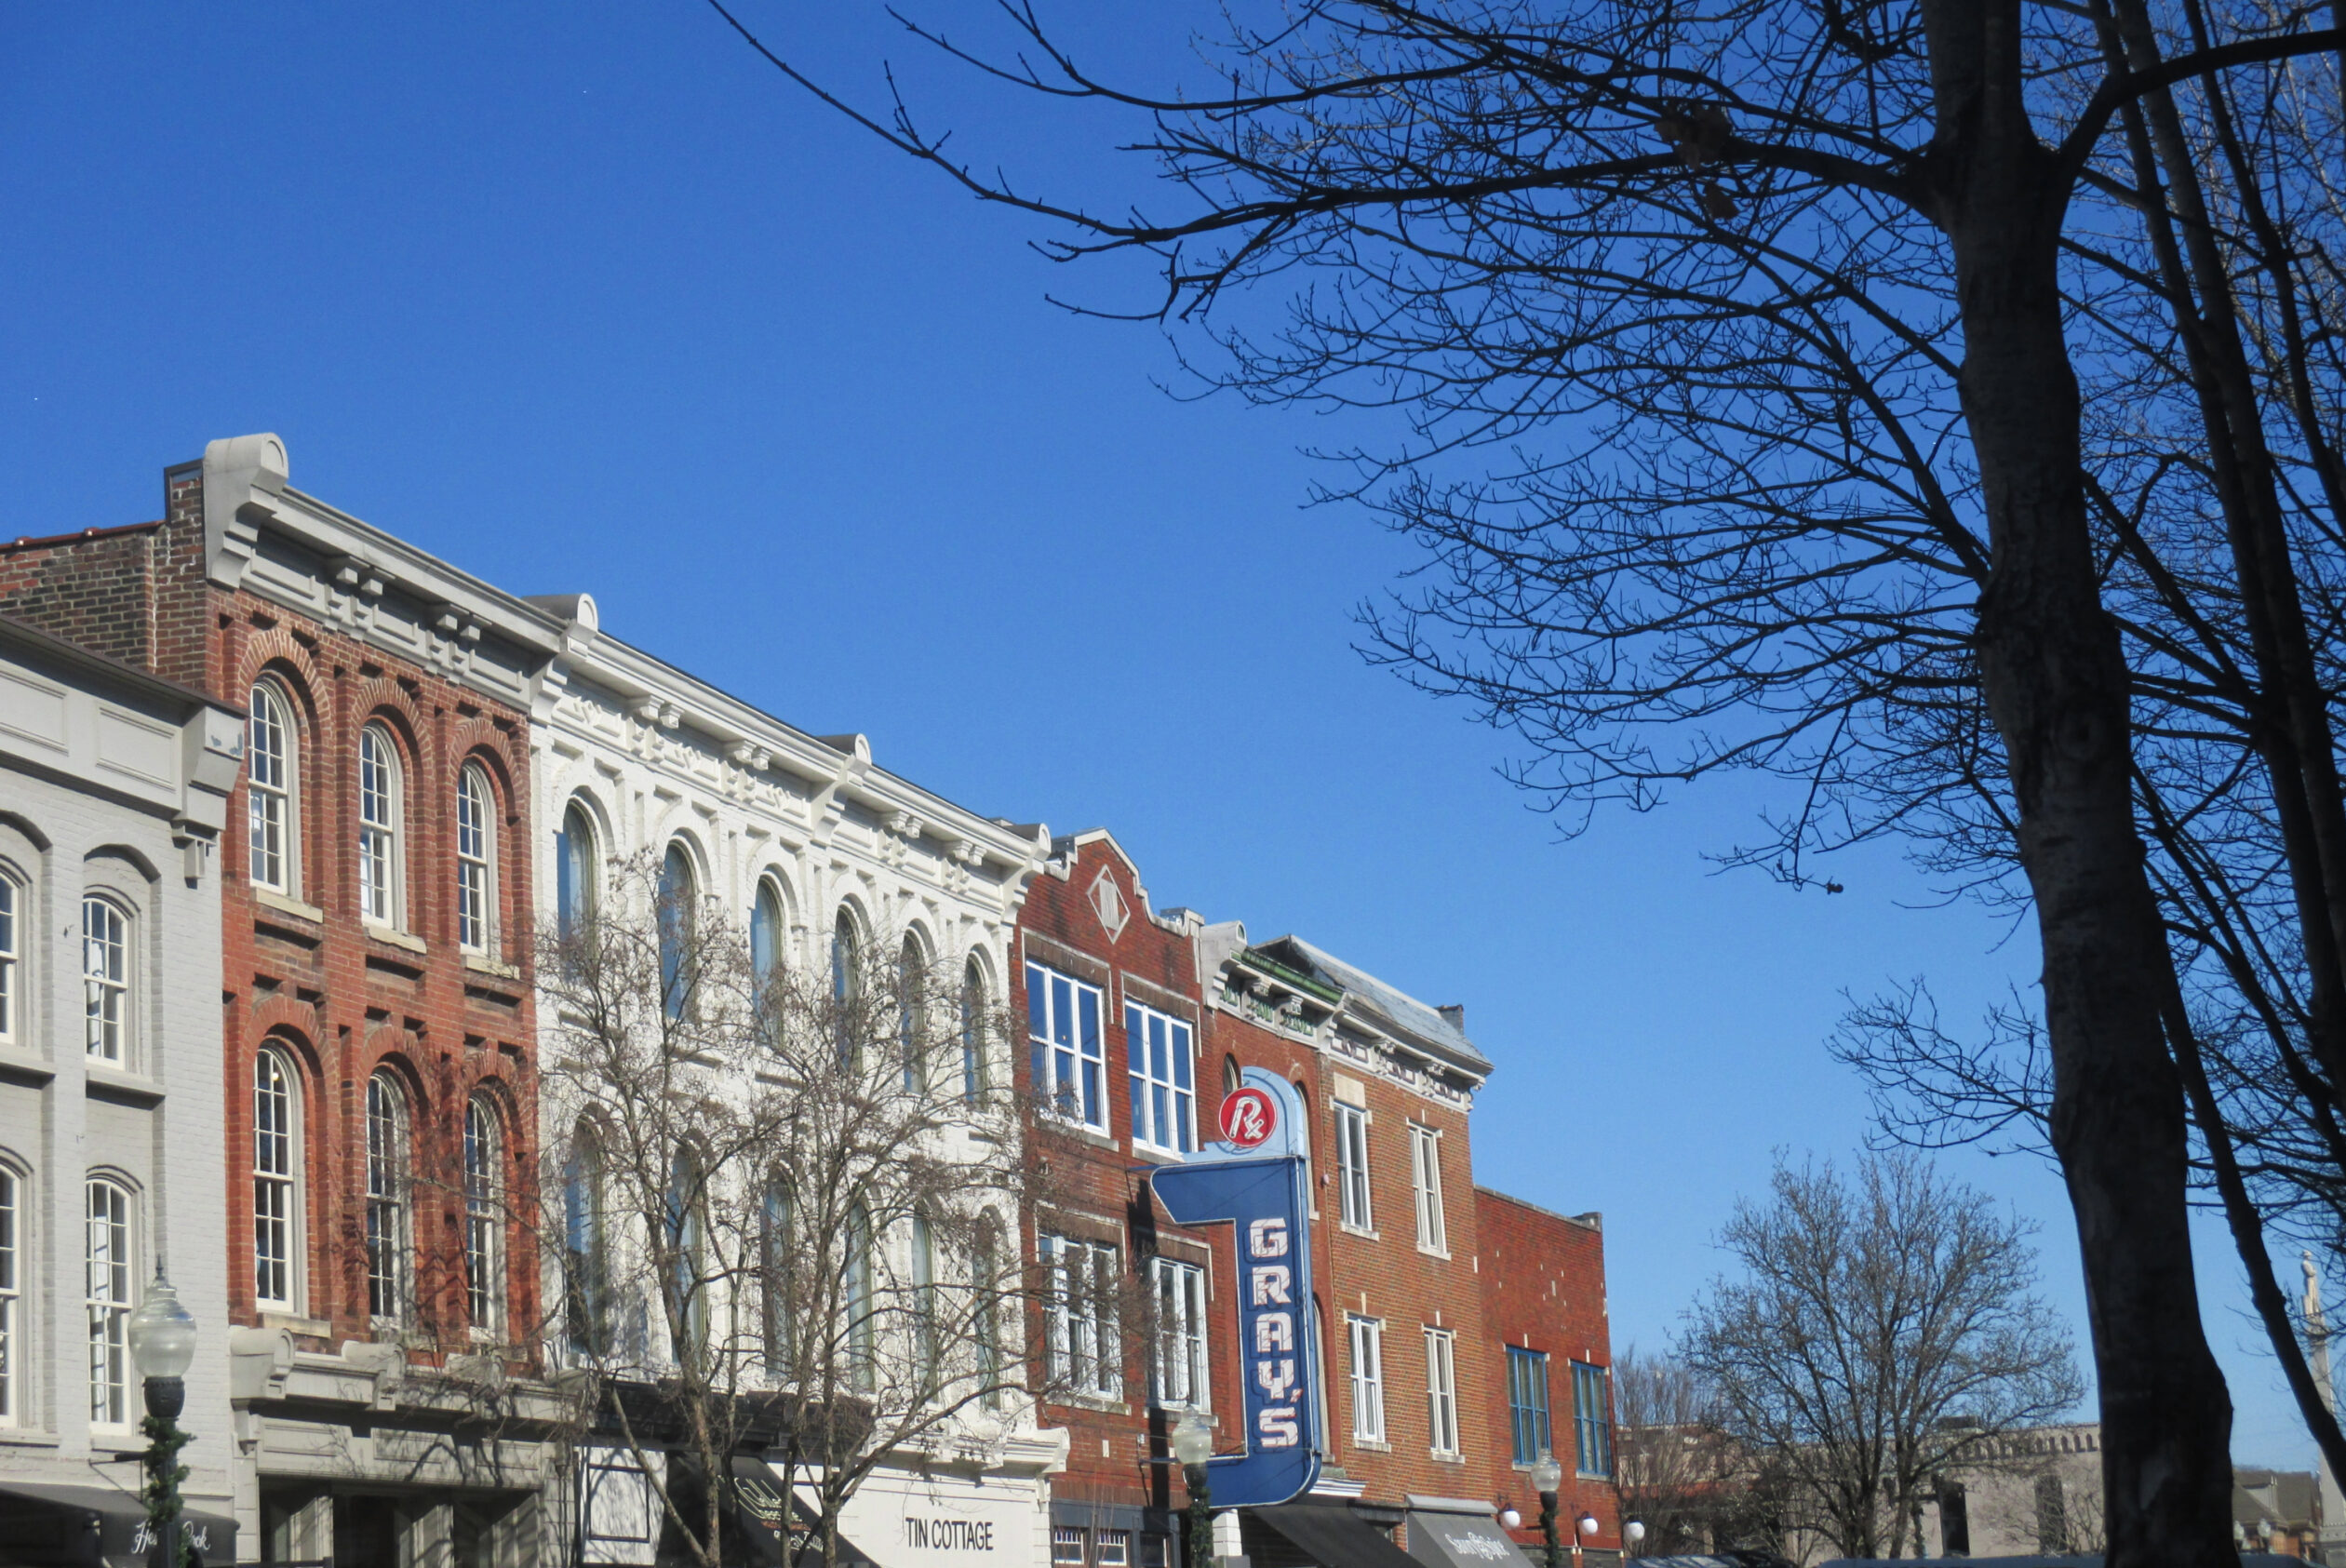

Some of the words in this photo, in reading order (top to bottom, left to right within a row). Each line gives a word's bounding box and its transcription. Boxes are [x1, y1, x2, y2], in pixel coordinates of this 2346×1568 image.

[1250, 1217, 1303, 1448] GRAY'S
[905, 1517, 928, 1548] TIN
[932, 1519, 993, 1550] COTTAGE
